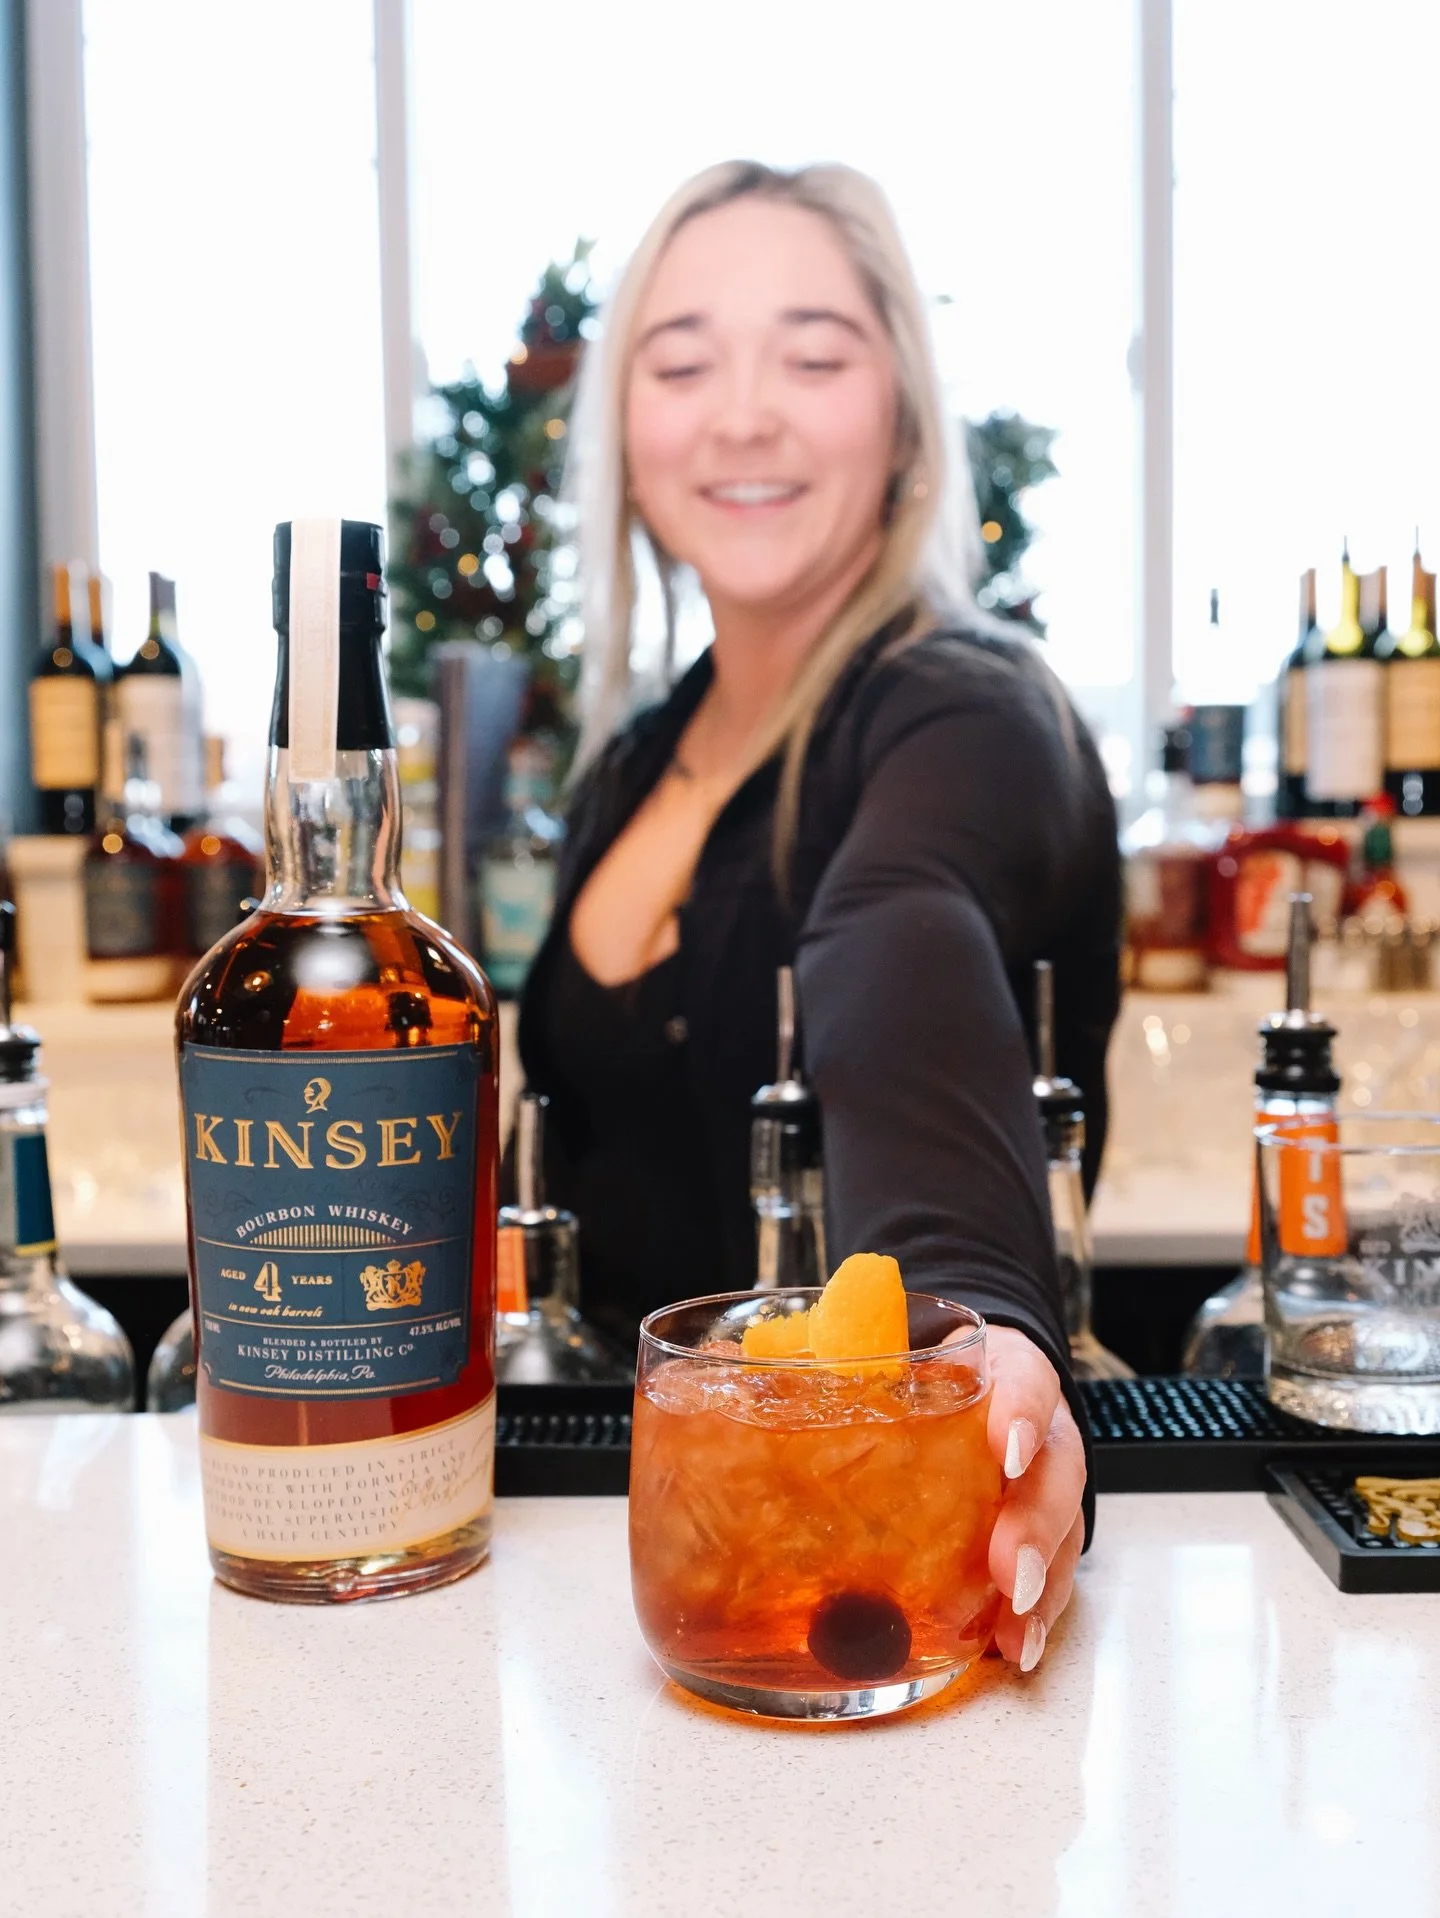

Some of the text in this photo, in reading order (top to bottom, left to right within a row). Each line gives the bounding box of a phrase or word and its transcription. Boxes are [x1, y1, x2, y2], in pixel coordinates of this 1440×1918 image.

[194, 1111, 463, 1170] KINSEY
[236, 1204, 414, 1239] BOURBON WHISKEY
[220, 1261, 333, 1303] AGED 4 YEARS
[228, 1302, 238, 1312] in
[260, 1305, 281, 1317] oak
[281, 1305, 323, 1318] barrels
[409, 1324, 433, 1337] 47.5%
[262, 1336, 383, 1348] BLENDED & BOTTLED BY
[238, 1344, 290, 1361] KINSEY
[296, 1346, 394, 1362] DISTILLING
[258, 1464, 354, 1479] PRODUCED
[367, 1461, 386, 1473] IN
[285, 1482, 332, 1495] WITH
[253, 1494, 361, 1511] DEVELOPED
[256, 1529, 299, 1541] HALF
